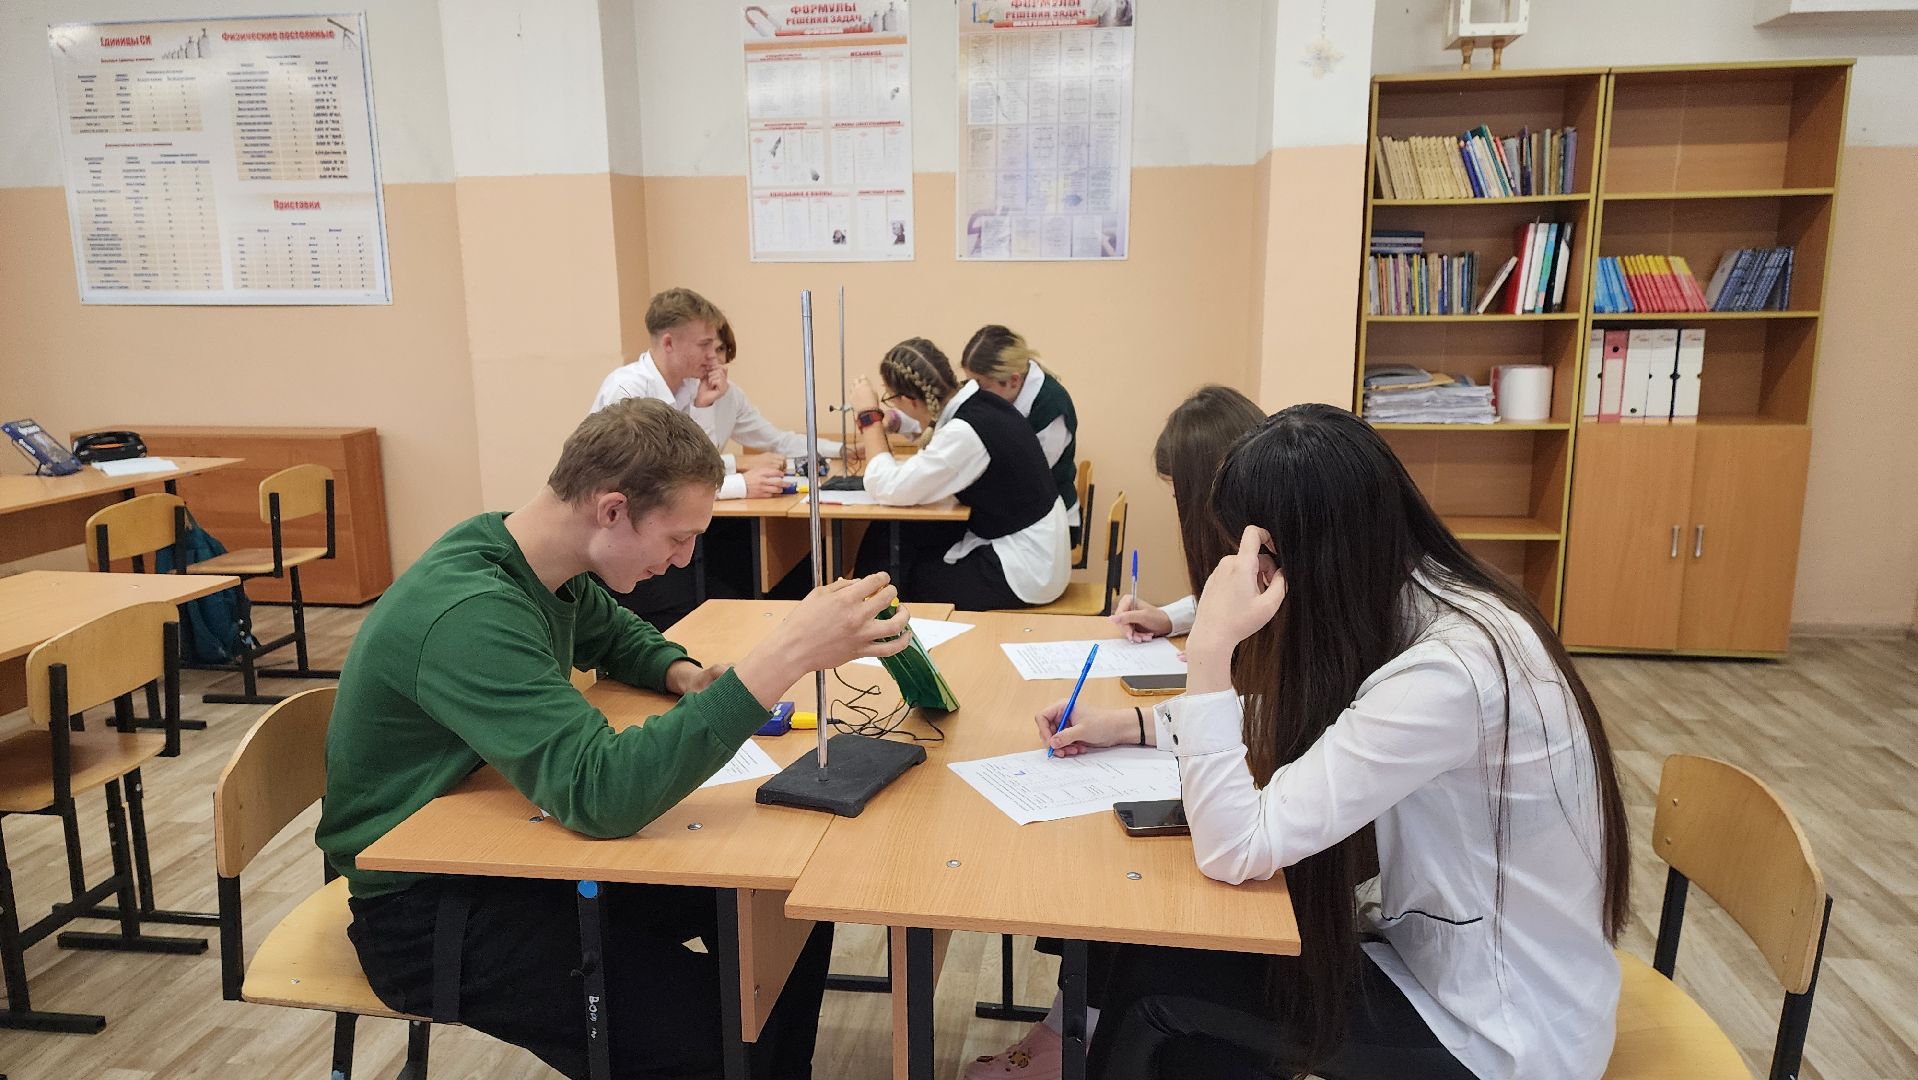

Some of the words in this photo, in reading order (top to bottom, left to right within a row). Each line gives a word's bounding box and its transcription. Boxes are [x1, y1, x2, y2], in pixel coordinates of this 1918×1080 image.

[790, 3, 857, 14] ФОРМУЛЫ
[785, 15, 829, 25] РЕШЕНИЯ
[830, 14, 862, 24] ЗАДАЧ
[273, 199, 321, 211] Приставки
